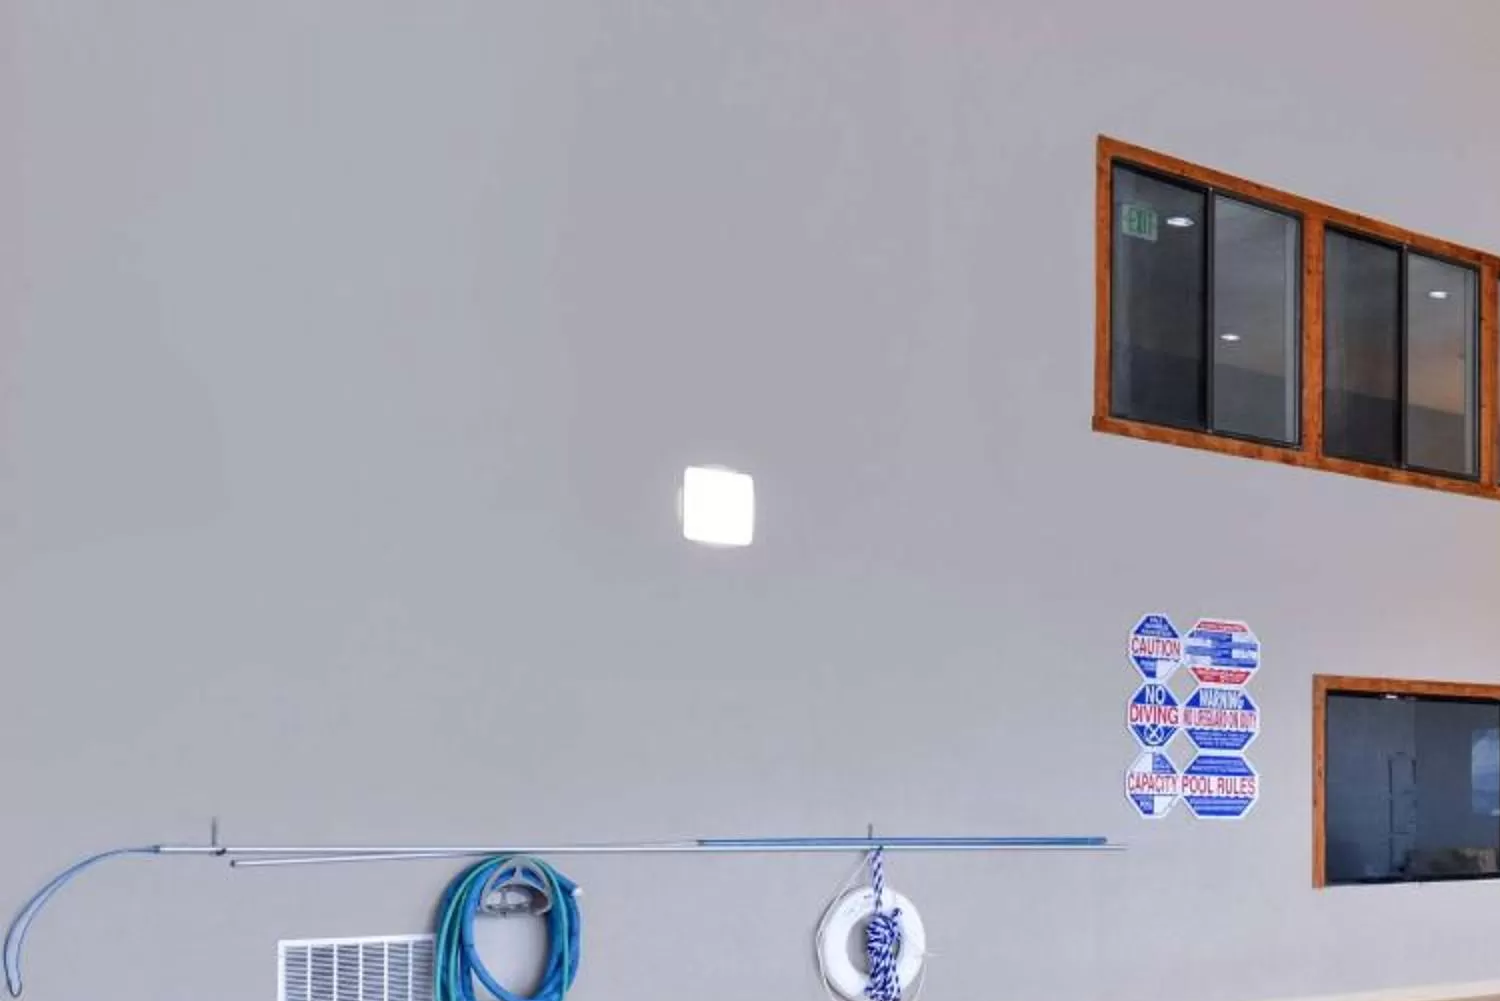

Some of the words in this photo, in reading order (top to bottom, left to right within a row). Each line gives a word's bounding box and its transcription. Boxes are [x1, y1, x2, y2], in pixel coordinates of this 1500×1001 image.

[1131, 638, 1181, 657] CAUTION
[1145, 685, 1166, 704] NO
[1130, 704, 1178, 725] DIVING
[1128, 772, 1178, 793] CAPACITY
[1182, 776, 1213, 794] POOL
[1217, 778, 1256, 795] RULES
